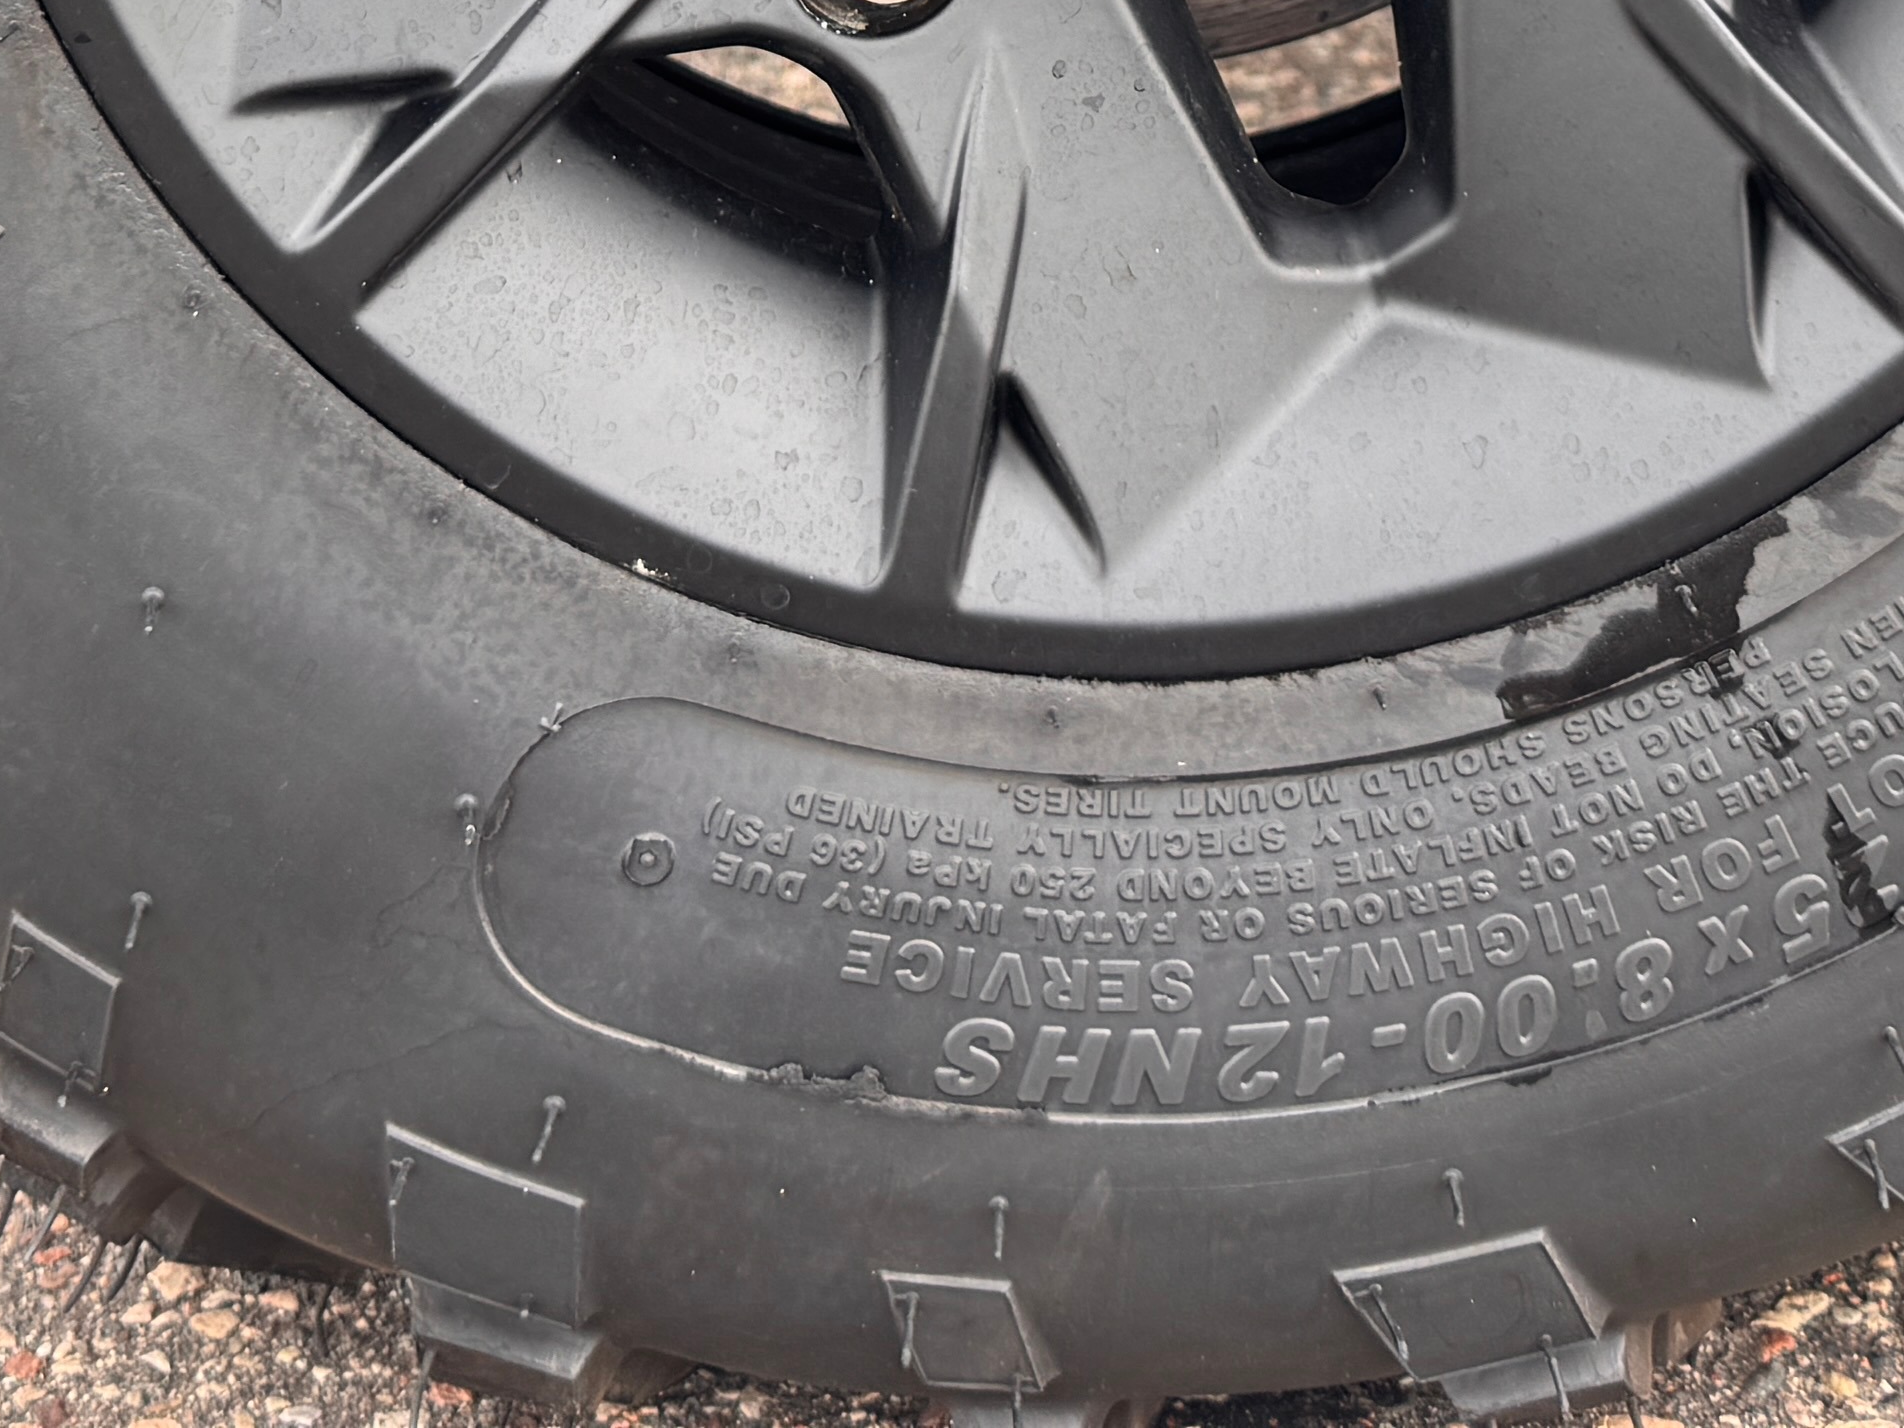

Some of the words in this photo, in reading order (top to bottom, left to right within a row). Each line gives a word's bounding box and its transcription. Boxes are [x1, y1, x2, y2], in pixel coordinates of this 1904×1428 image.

[1563, 636, 1774, 744] PERSONS
[1634, 646, 1837, 757] SEATING
[1172, 771, 1341, 819] MOUNT
[1360, 733, 1547, 799] SHOULD
[1652, 753, 1718, 797] DO
[1721, 754, 1814, 819] THE
[695, 791, 797, 859] PSI)
[781, 779, 995, 851] TRAINED
[994, 777, 1151, 820] TIRES.
[1308, 795, 1438, 849] ONLY
[1544, 775, 1647, 840] NOT
[806, 822, 888, 877] (36
[1015, 818, 1289, 860] SPECIALLY
[1331, 813, 1536, 888] INFLATE
[1590, 799, 1710, 866] RISK
[1644, 815, 1800, 914] FOR
[705, 847, 808, 907] DUE
[901, 846, 991, 892] kPa
[1007, 860, 1098, 900] 250
[1116, 856, 1317, 901] BEYOND
[1512, 843, 1581, 894] OF
[819, 875, 1004, 939] INJURY
[1021, 905, 1178, 946] FATAL
[1198, 905, 1266, 943] OR
[1285, 866, 1501, 937] SERIOUS
[838, 925, 1197, 1013] SERVICE
[1238, 884, 1621, 1008] HIGHWAY
